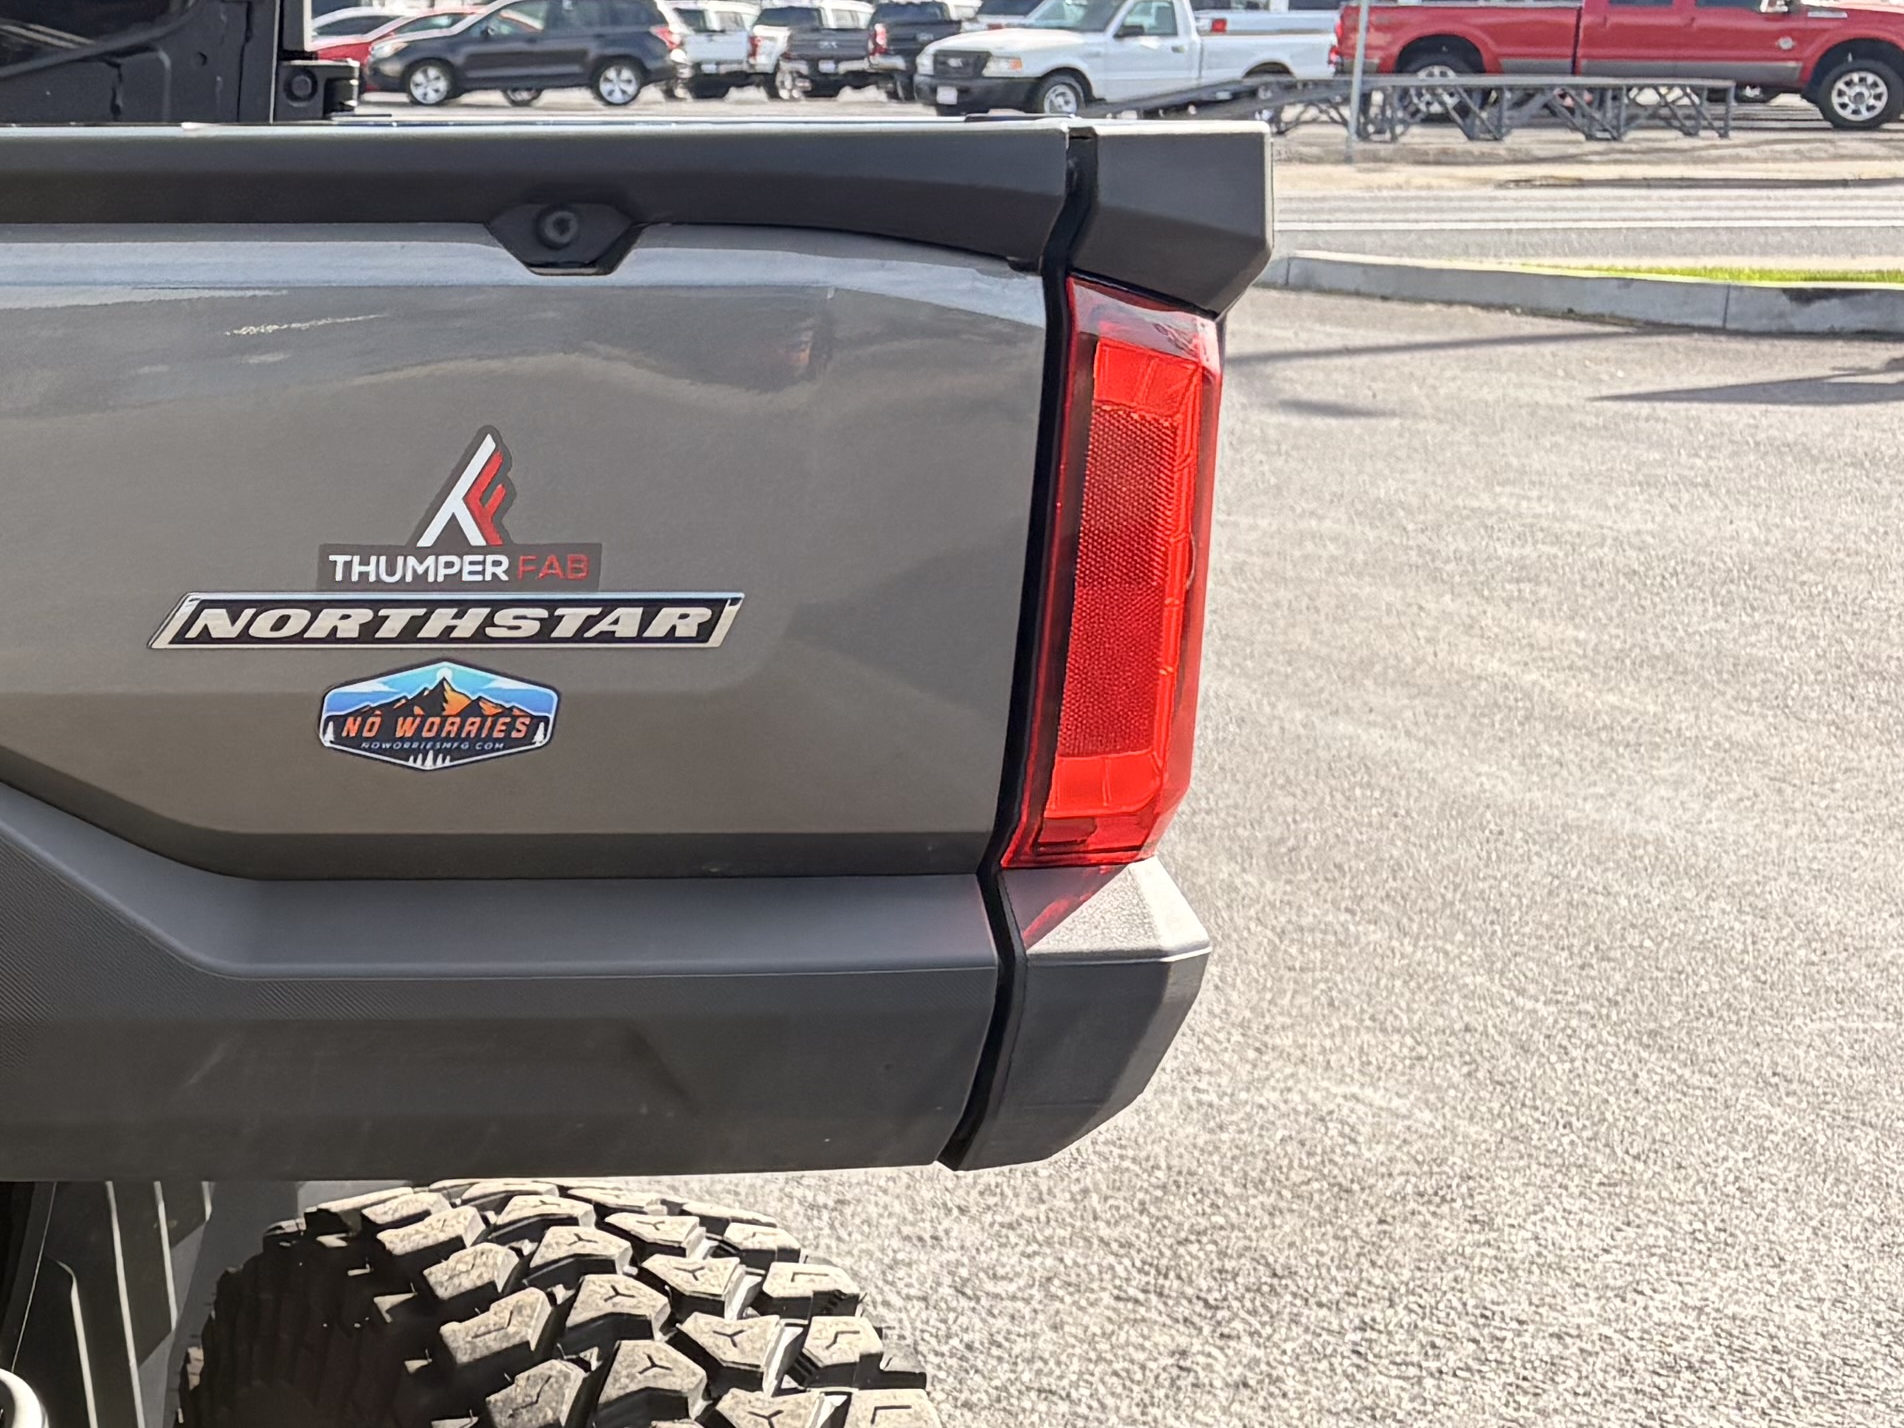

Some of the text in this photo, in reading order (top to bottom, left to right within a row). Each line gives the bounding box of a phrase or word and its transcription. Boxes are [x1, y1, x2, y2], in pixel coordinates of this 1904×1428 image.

[328, 553, 589, 583] THUMPER FAB
[191, 605, 714, 639] NORTHSTAR
[342, 716, 531, 739] NO WORRIES
